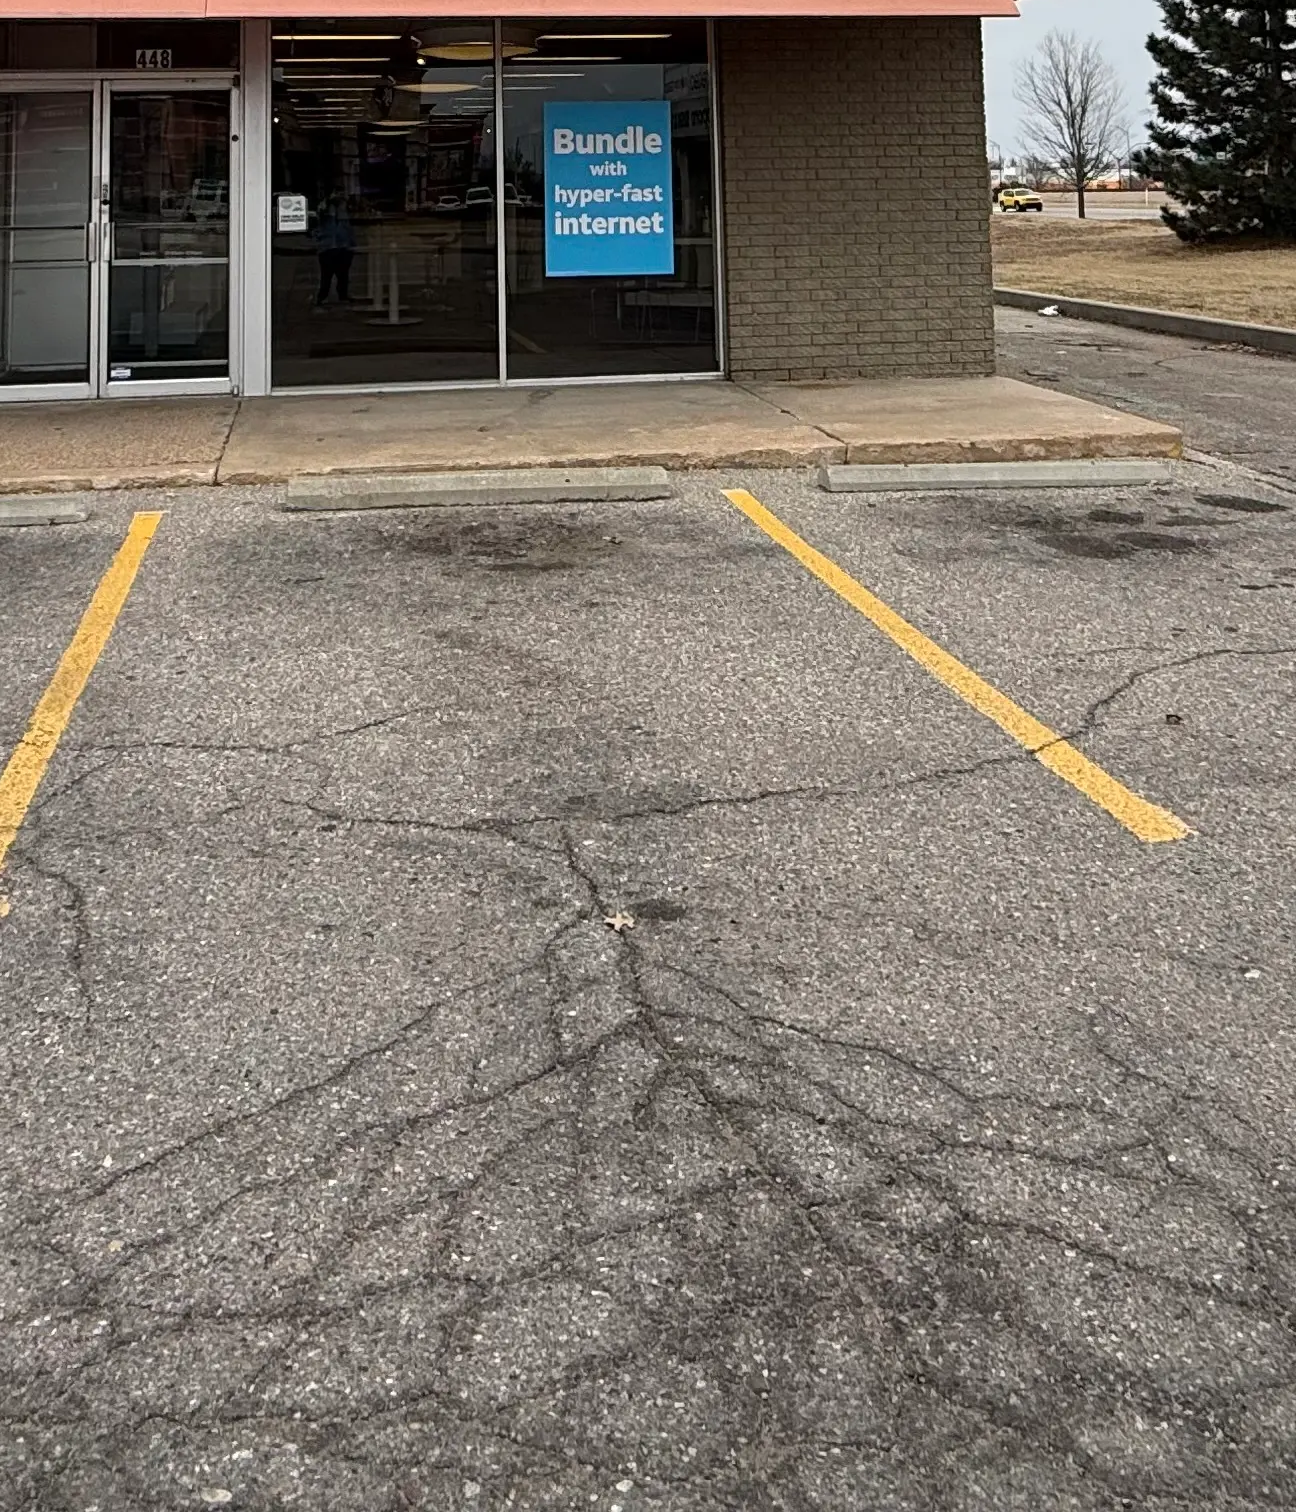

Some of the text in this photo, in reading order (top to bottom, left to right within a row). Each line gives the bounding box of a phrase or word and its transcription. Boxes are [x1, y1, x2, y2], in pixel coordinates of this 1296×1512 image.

[137, 49, 170, 69] 448
[553, 125, 663, 155] Bundle
[589, 160, 628, 177] with
[554, 183, 664, 208] hyper-fast
[554, 211, 665, 236] internet
